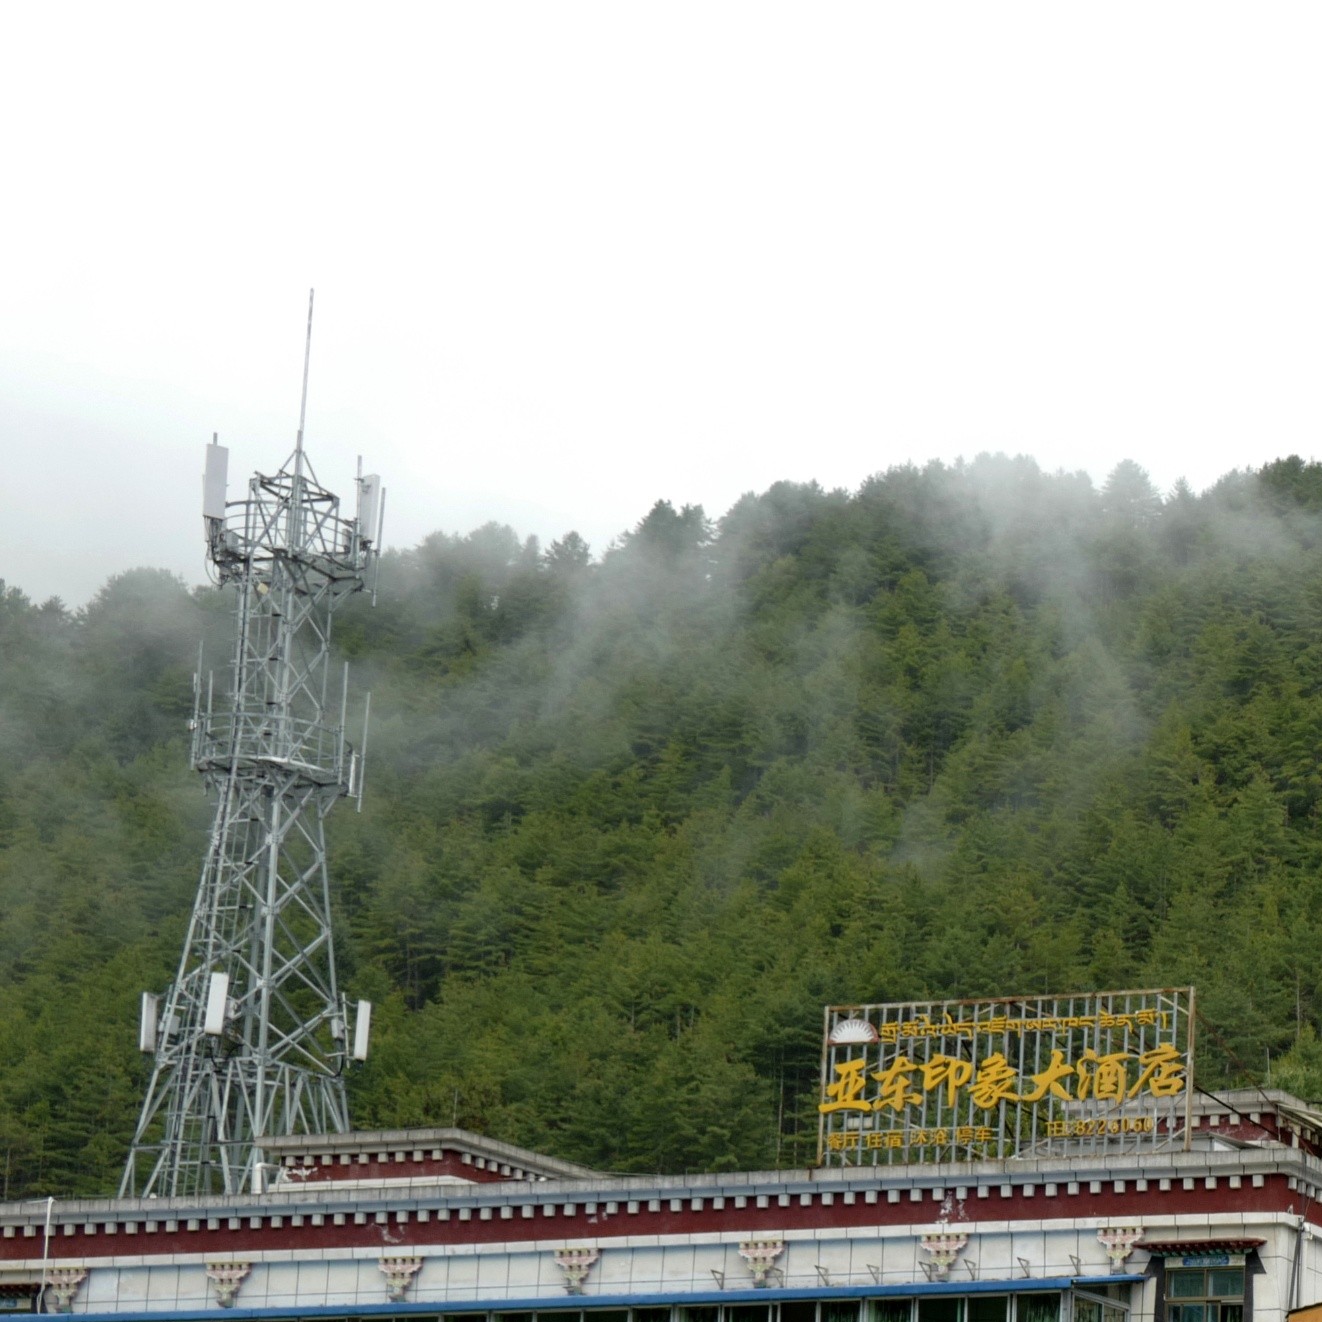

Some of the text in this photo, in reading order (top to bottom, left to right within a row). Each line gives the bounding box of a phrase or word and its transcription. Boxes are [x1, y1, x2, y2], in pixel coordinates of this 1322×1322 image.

[818, 1043, 1187, 1113] 亚东印象大酒店
[956, 1125, 993, 1145] 停车
